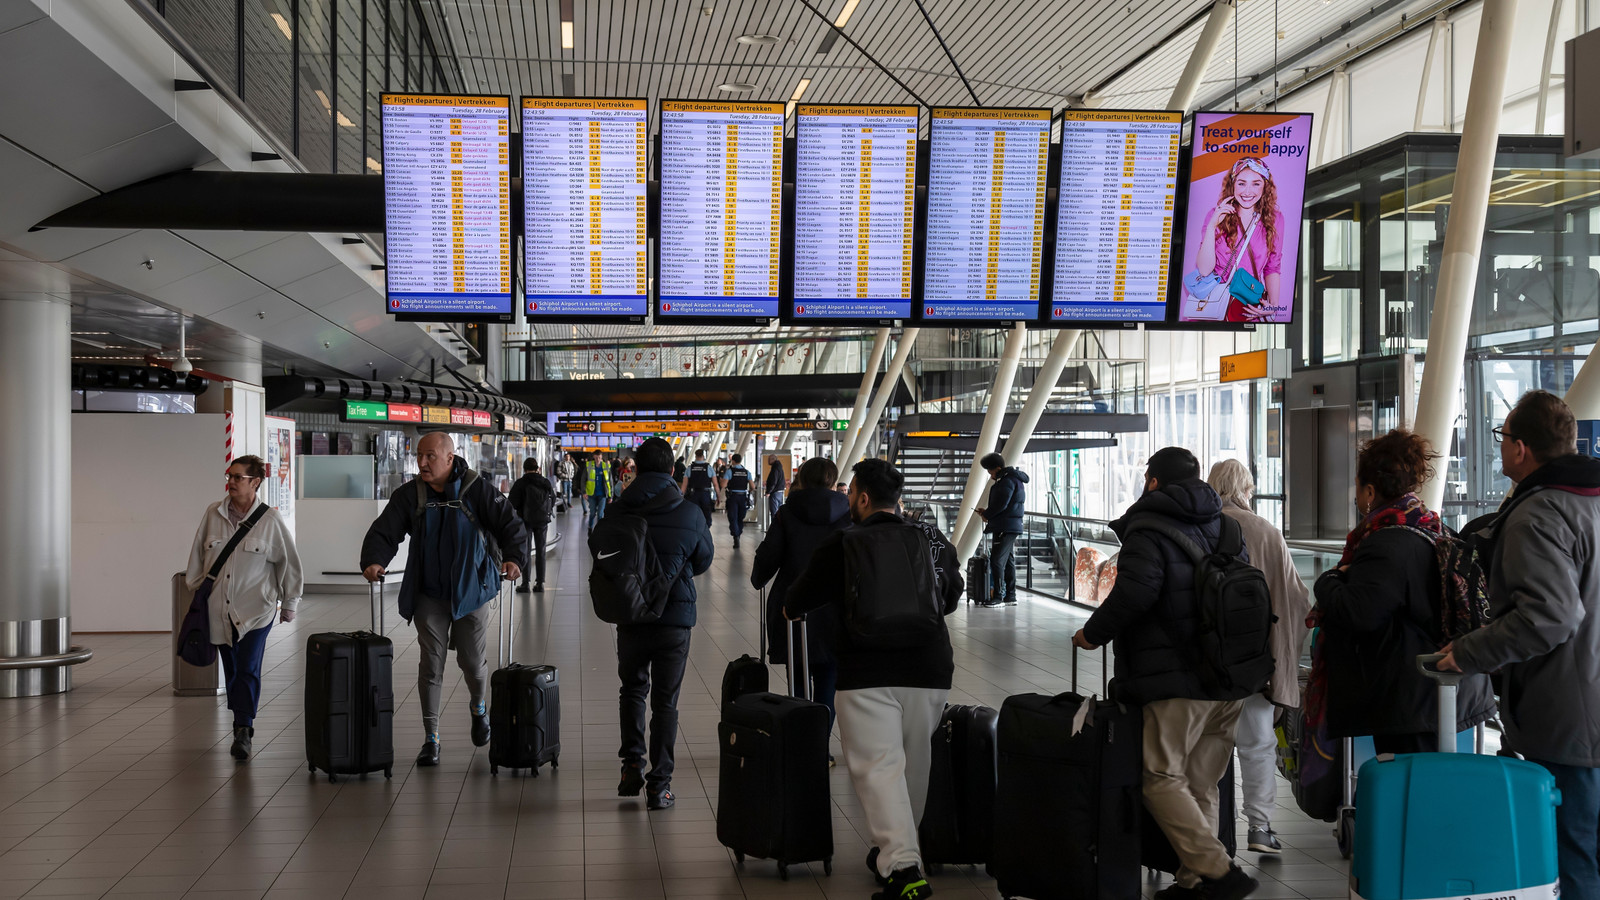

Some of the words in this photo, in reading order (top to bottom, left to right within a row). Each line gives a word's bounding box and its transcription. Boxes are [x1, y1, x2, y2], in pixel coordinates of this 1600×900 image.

[393, 96, 413, 104] Flight
[415, 97, 452, 105] departures
[555, 100, 591, 108] departures
[694, 103, 730, 111] departures
[963, 110, 998, 118] departures
[1200, 125, 1234, 138] Treat
[1236, 126, 1293, 141] yourself
[1205, 141, 1219, 153] to
[1222, 143, 1259, 154] some
[1262, 141, 1305, 157] happy
[1262, 305, 1288, 313] Schiphol
[961, 330, 971, 340] 29
[1228, 363, 1236, 373] Lift
[348, 405, 356, 415] Tax
[357, 405, 367, 416] Free
[429, 414, 440, 422] TICKET
[452, 414, 463, 423] TICKET
[464, 415, 472, 424] DESK
